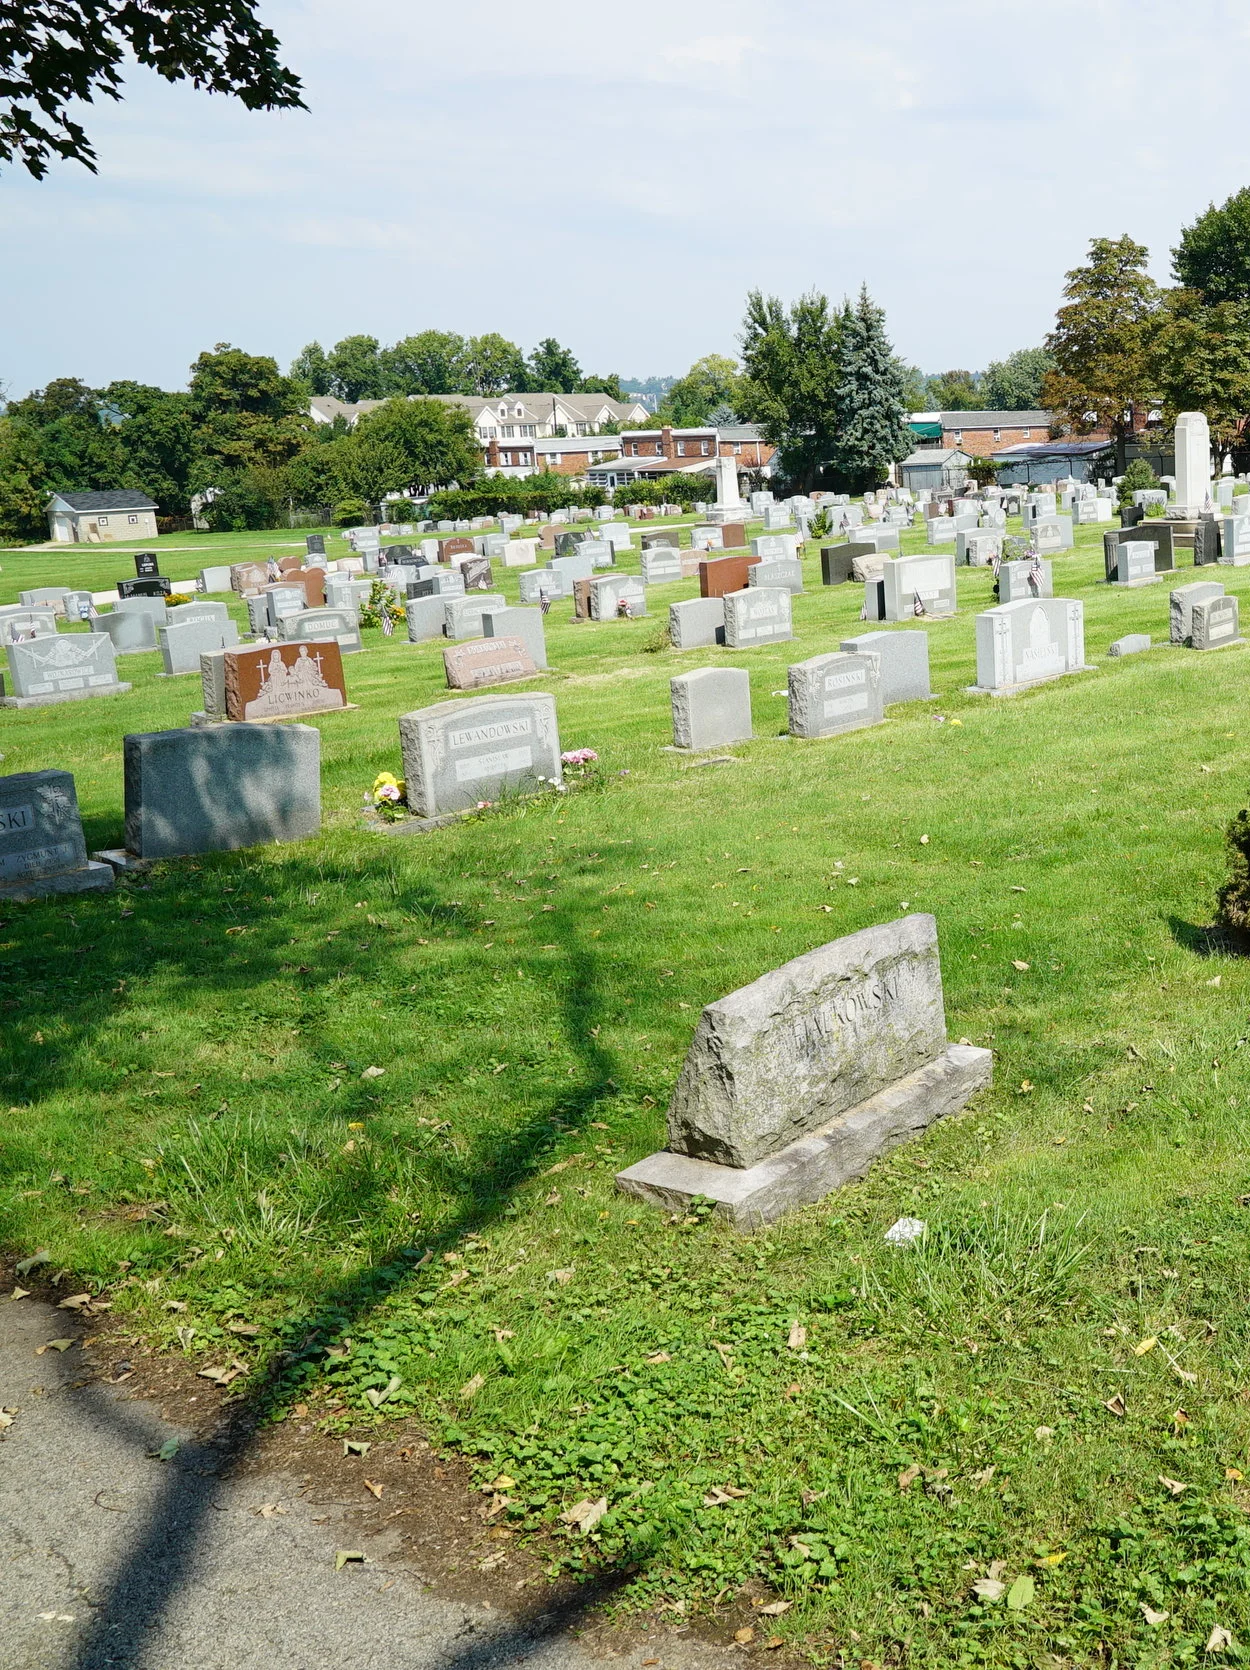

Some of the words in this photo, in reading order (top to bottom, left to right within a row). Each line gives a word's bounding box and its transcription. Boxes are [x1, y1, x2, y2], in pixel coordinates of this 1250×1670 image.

[268, 688, 320, 705] LICWINKO
[453, 720, 529, 746] LEWANDOWSKI
[17, 846, 58, 862] ZYGMUNT
